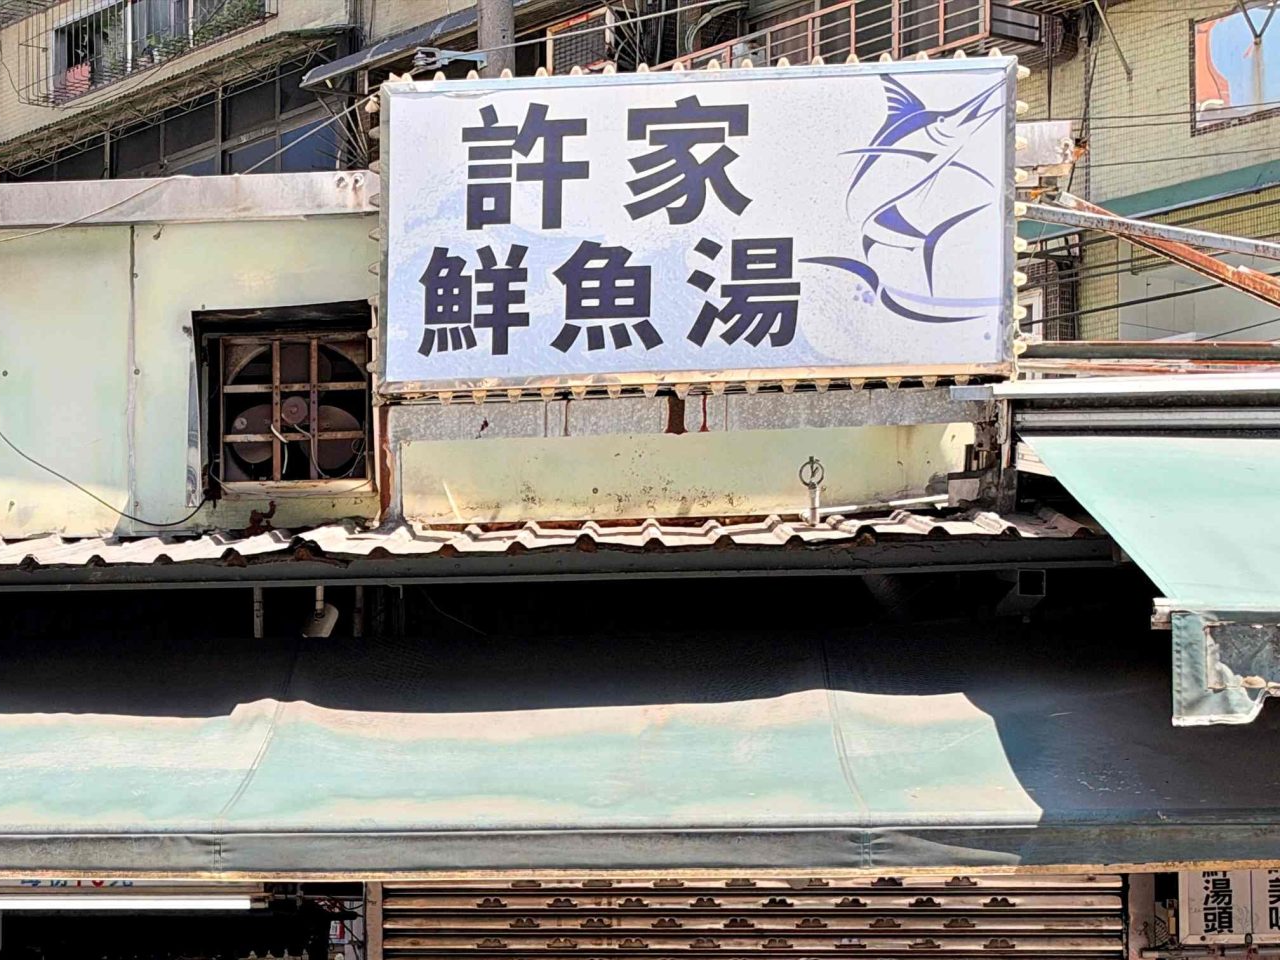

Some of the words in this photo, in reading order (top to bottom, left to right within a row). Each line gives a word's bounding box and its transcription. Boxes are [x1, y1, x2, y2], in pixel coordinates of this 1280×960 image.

[461, 95, 753, 231] 許家
[416, 236, 802, 358] 鮮魚湯
[1202, 871, 1234, 934] 湯頭
